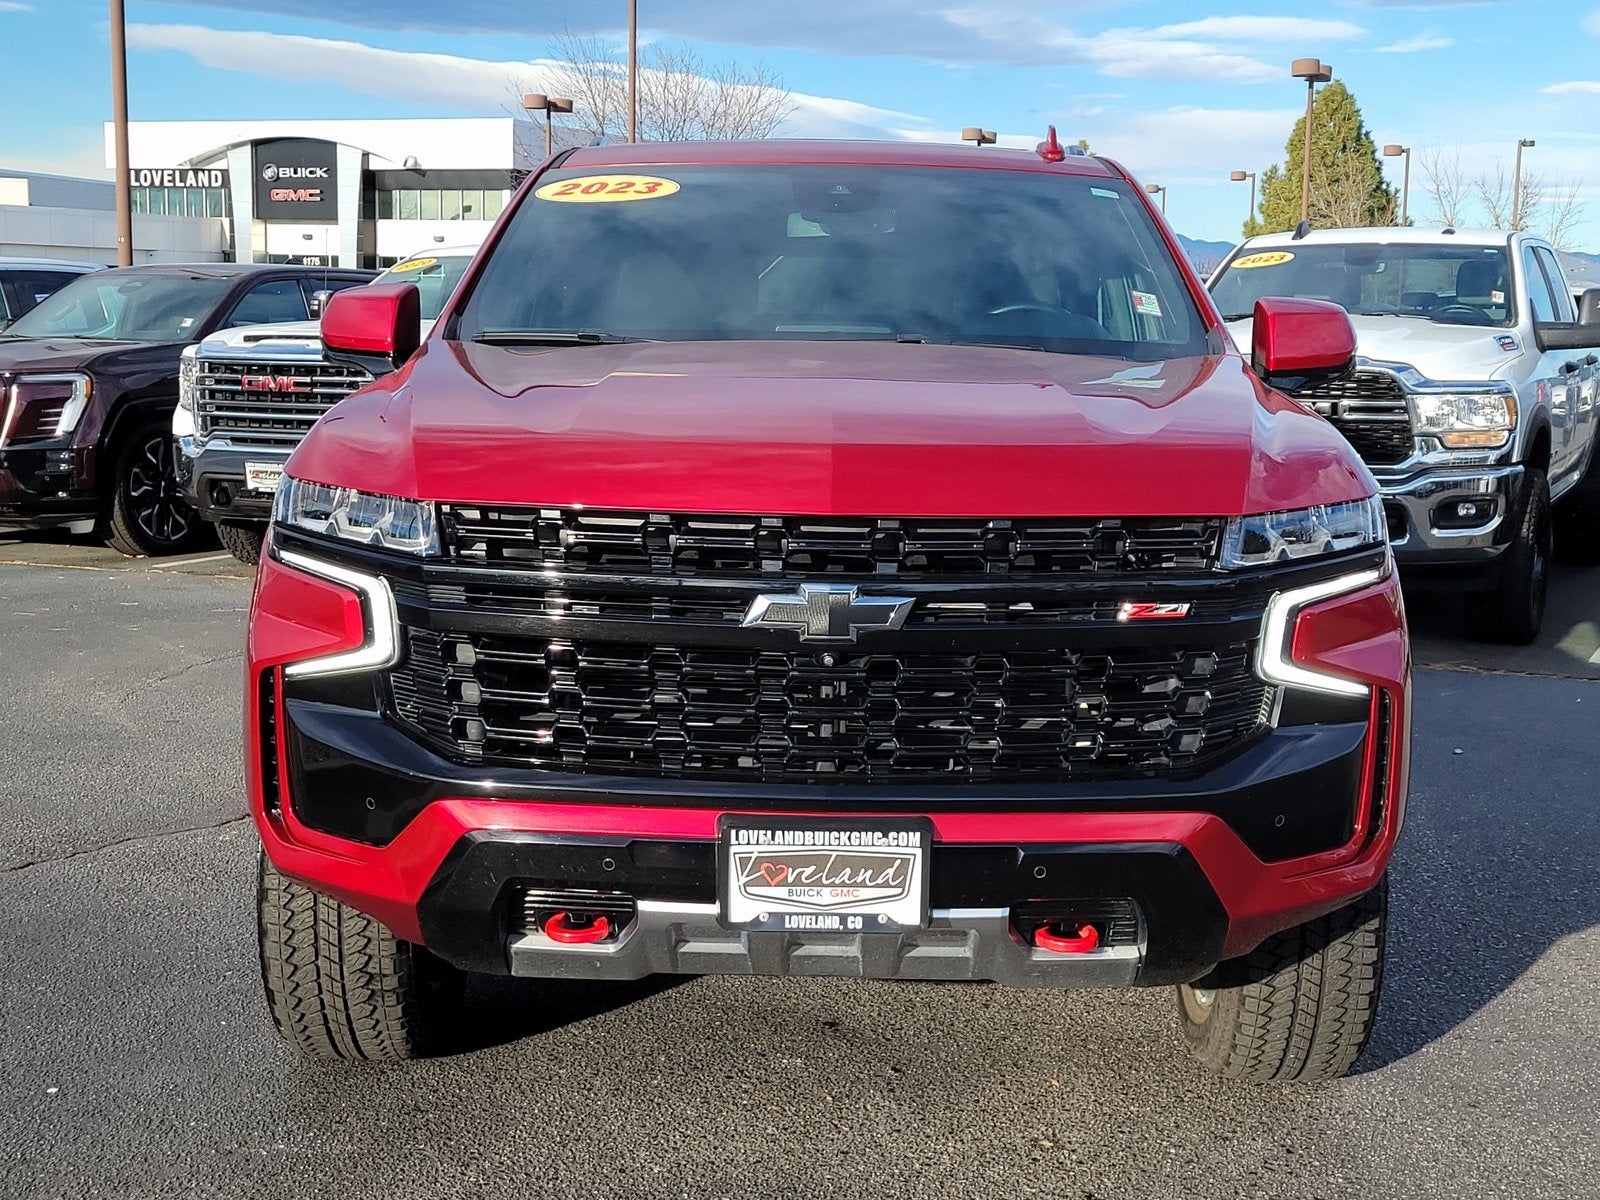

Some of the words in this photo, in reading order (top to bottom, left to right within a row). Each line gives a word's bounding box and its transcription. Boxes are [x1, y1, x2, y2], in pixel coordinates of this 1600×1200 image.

[130, 169, 222, 188] LOVELAND
[279, 167, 329, 178] BUICK
[270, 189, 321, 202] GMC
[552, 181, 663, 196] 2023
[1239, 254, 1287, 265] 2023
[241, 375, 311, 392] GMC
[737, 851, 905, 887] Loveland
[787, 888, 823, 898] BUICK
[829, 889, 861, 898] GMC
[785, 915, 844, 930] LOVELAND,
[847, 916, 863, 930] CO
